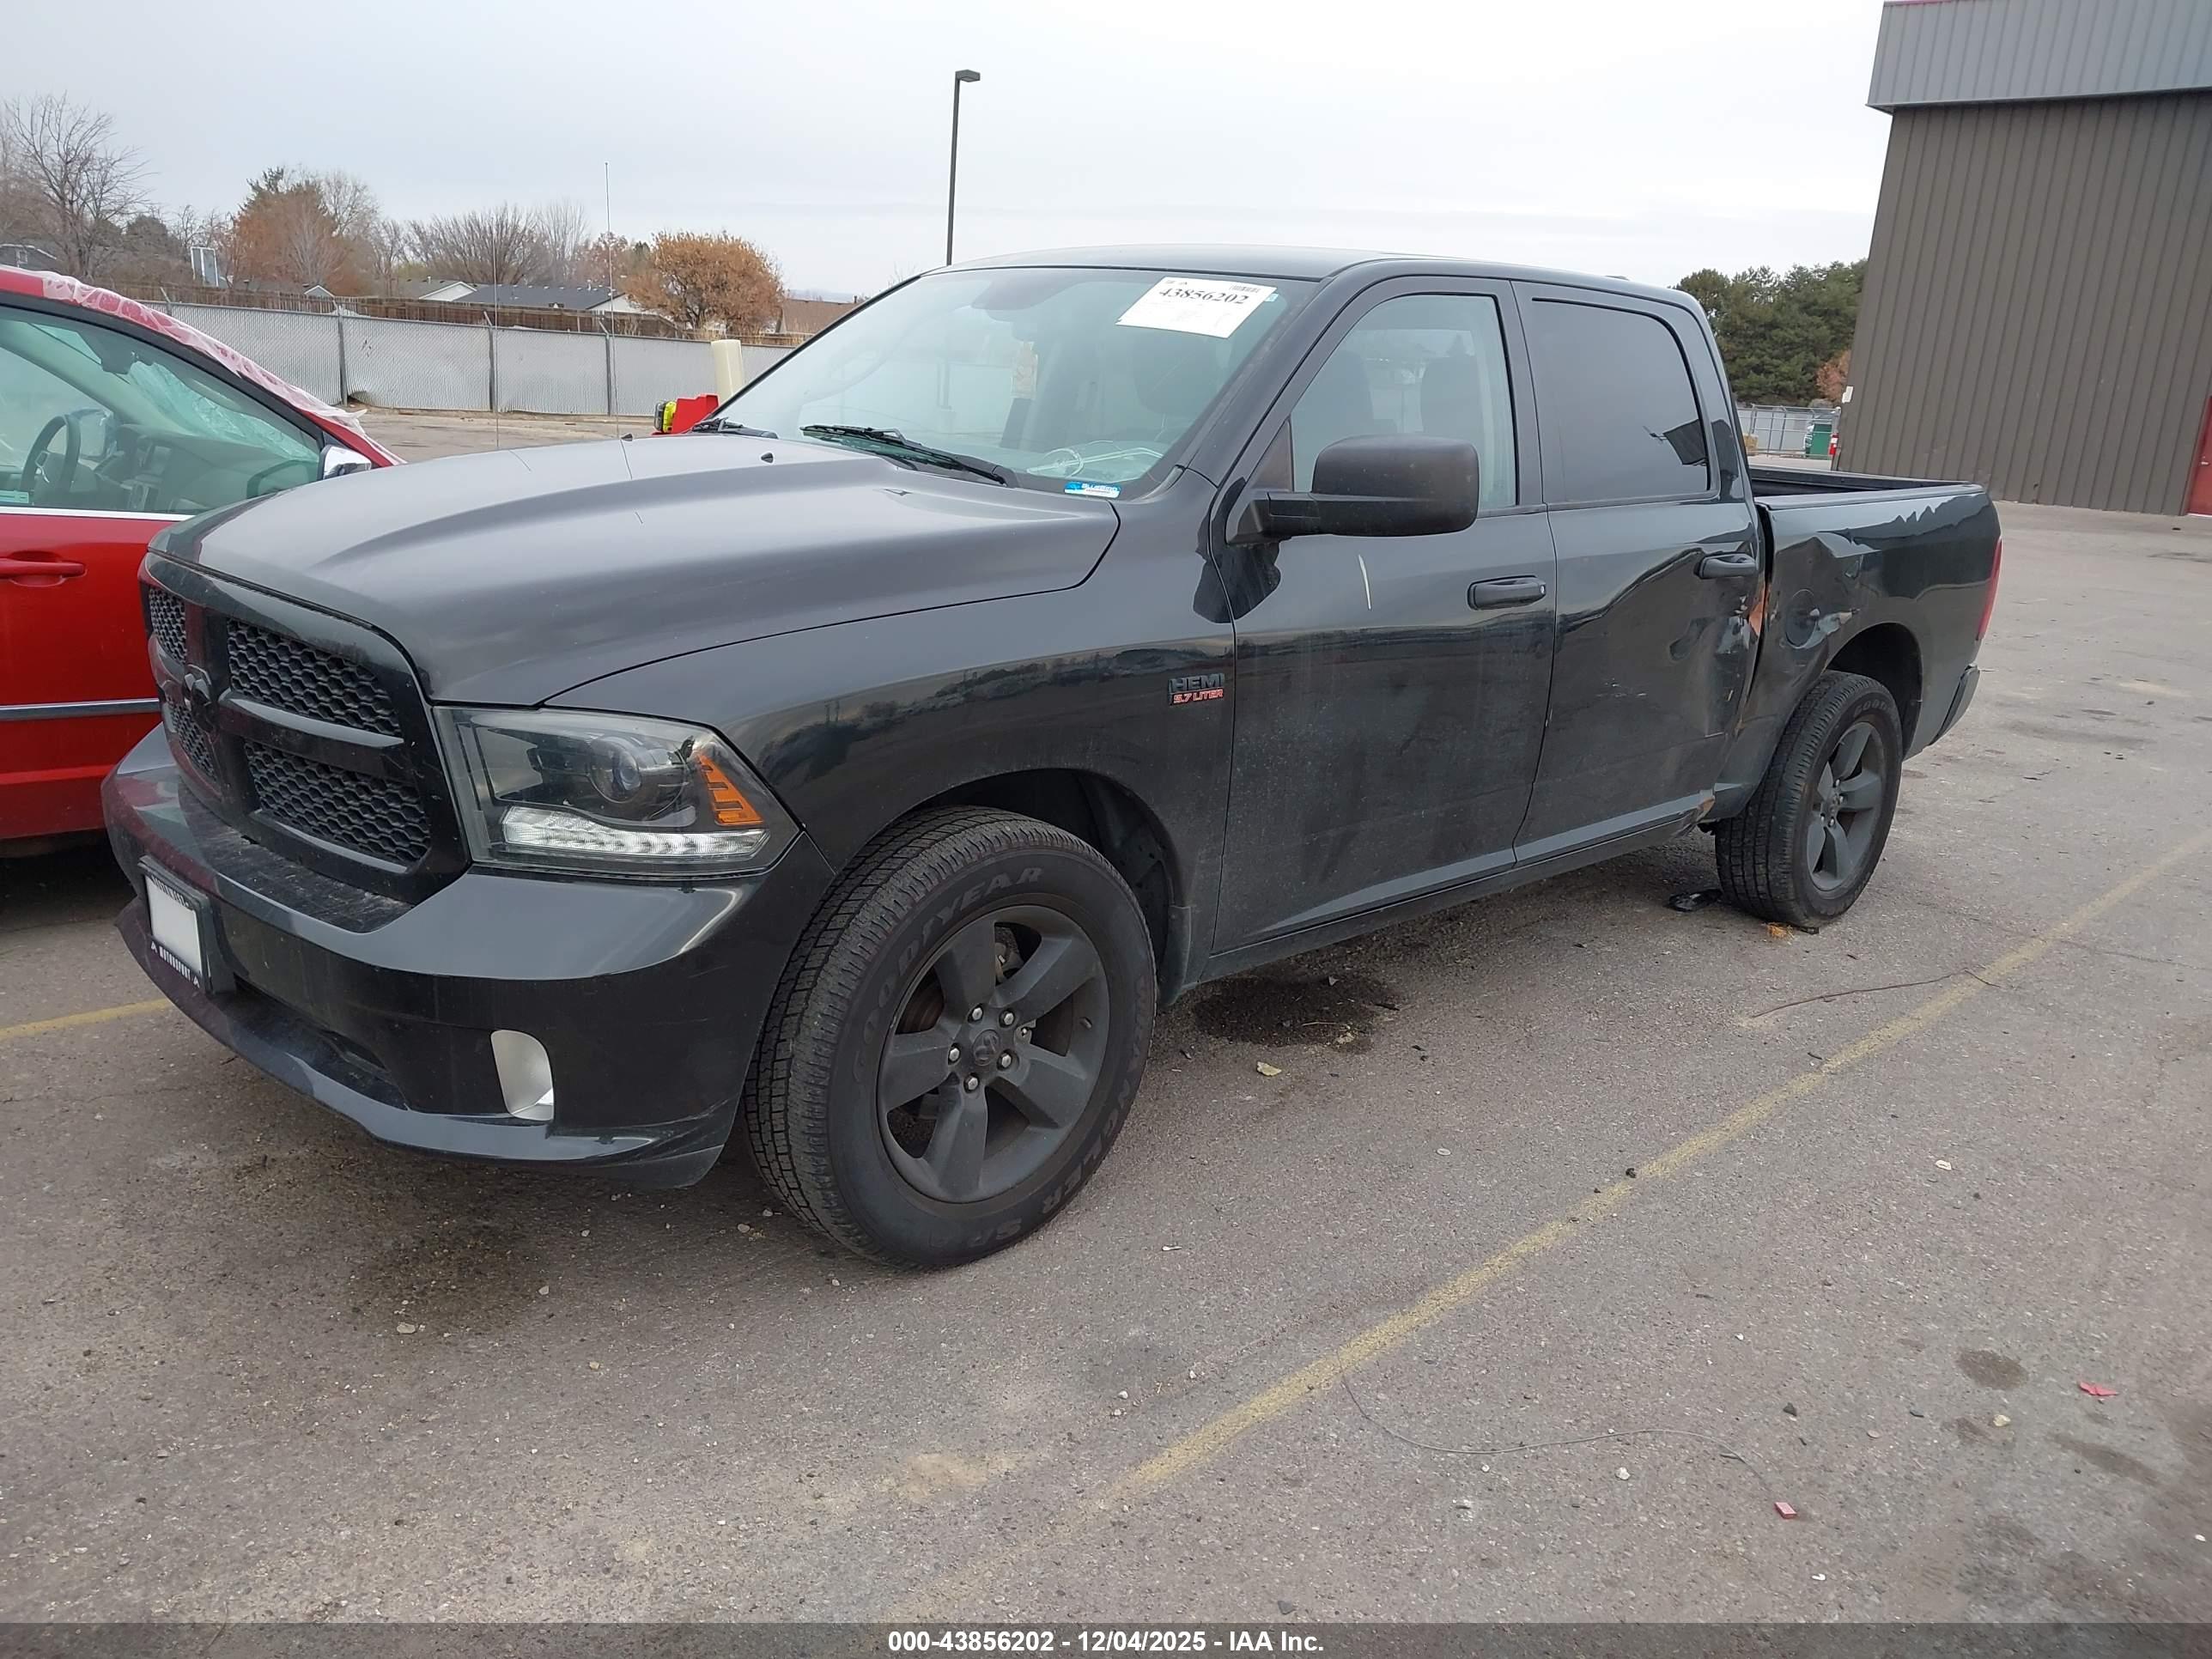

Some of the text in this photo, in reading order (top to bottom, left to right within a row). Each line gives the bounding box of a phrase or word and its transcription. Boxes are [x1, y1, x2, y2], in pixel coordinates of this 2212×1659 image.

[1158, 287, 1249, 305] 43856202
[1169, 673, 1224, 694] HEMI
[1173, 689, 1224, 704] 5.7 LITER
[852, 866, 1043, 1084] GOODYEAR
